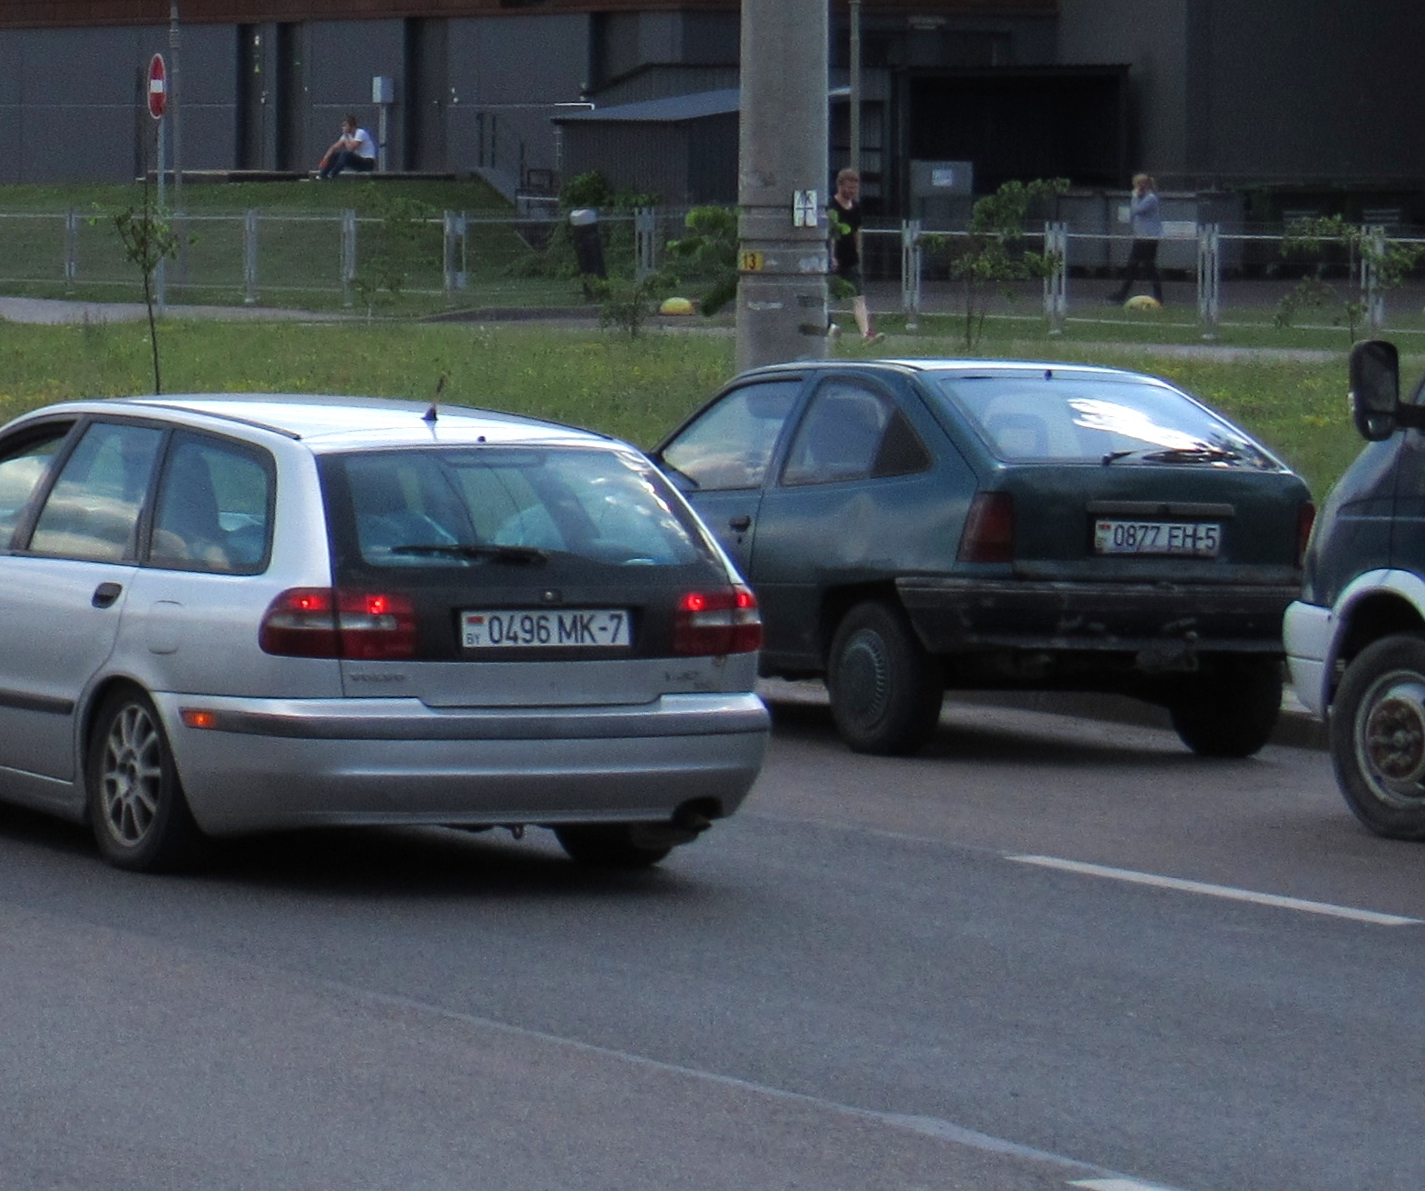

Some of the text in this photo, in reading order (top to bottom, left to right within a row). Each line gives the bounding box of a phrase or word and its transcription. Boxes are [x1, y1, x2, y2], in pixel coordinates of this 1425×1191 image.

[744, 253, 756, 270] 13
[1114, 524, 1217, 550] 0877 EH-5
[489, 614, 623, 643] 0496 MK-7
